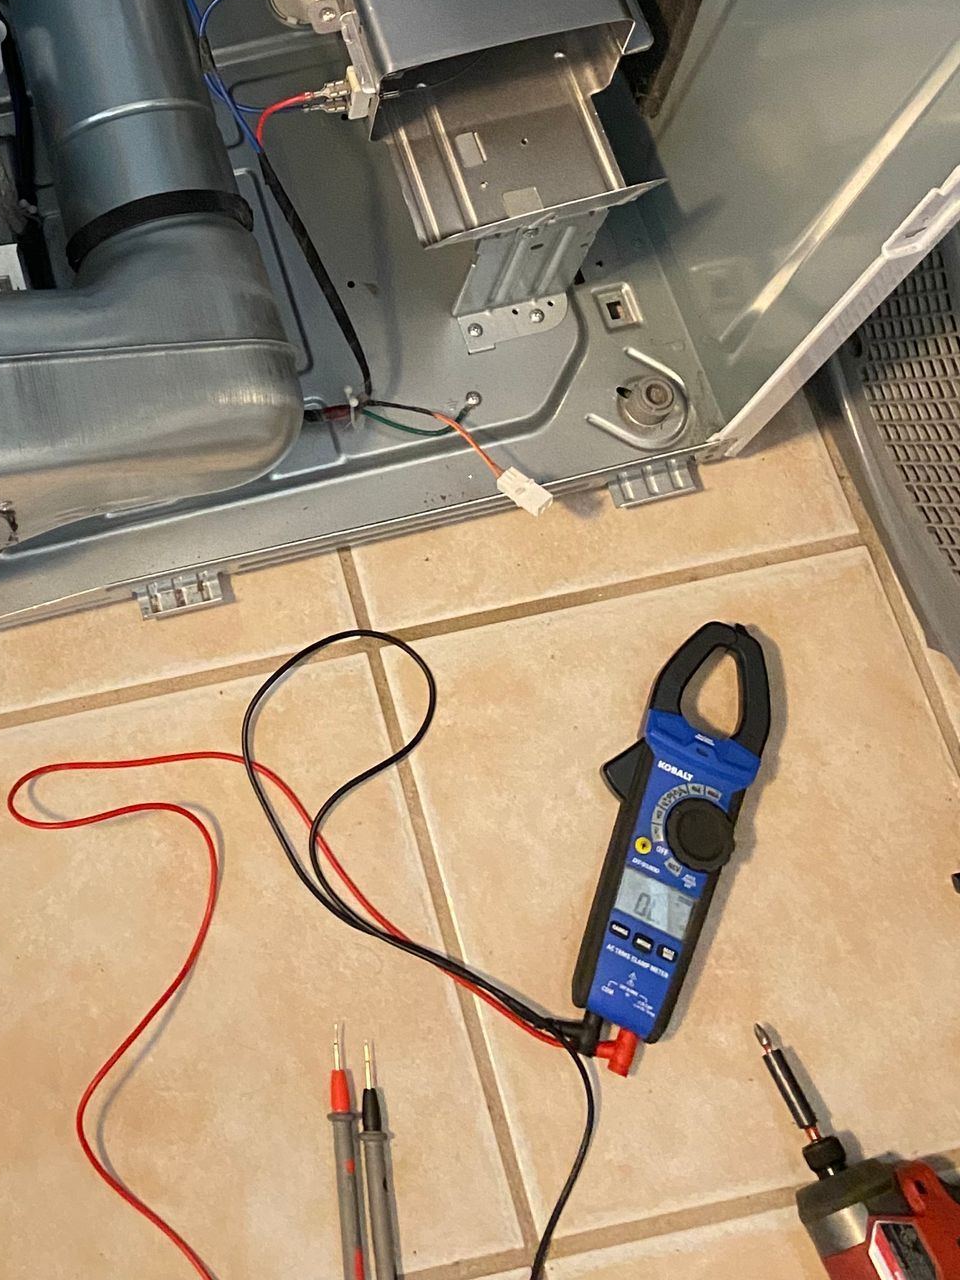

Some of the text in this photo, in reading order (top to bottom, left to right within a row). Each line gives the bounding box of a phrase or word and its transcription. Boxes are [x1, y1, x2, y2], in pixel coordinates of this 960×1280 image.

[657, 760, 694, 782] KOBALT
[606, 943, 615, 953] AC
[649, 964, 669, 979] METER
